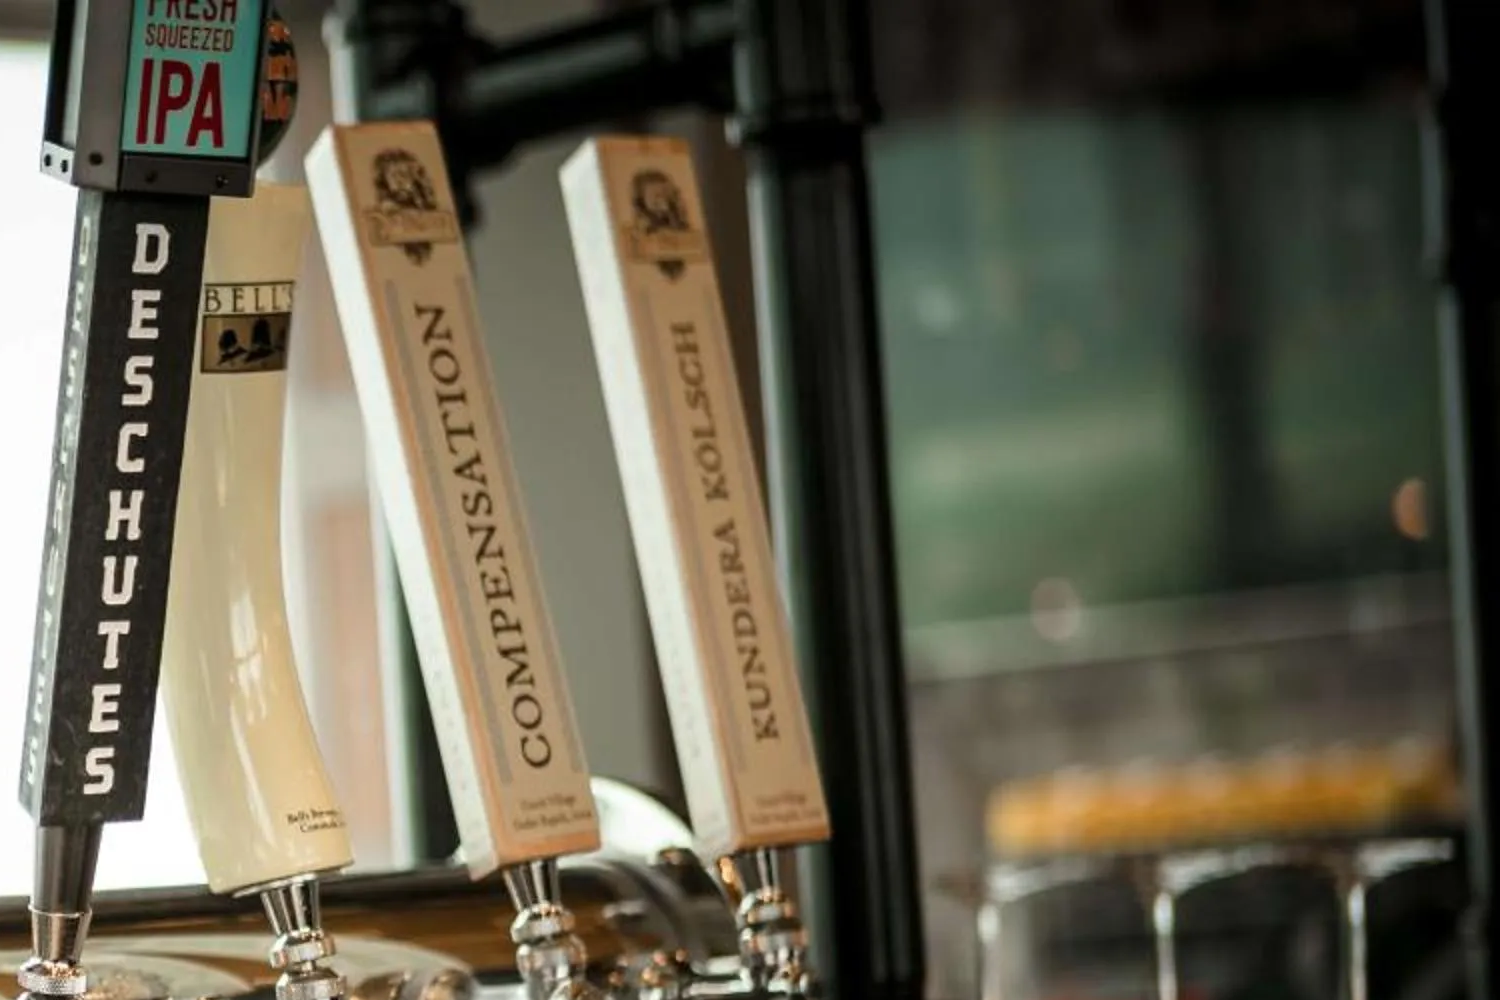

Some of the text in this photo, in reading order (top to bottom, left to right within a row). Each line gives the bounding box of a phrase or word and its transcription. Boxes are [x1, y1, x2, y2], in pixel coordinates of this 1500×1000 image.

[136, 58, 224, 148] IPA
[145, 23, 234, 52] SQUEEZED
[82, 222, 171, 796] DESCHUTES
[671, 320, 734, 502] KOLSCH
[414, 301, 552, 769] COMPENSATION
[712, 518, 781, 744] KUNDERA
